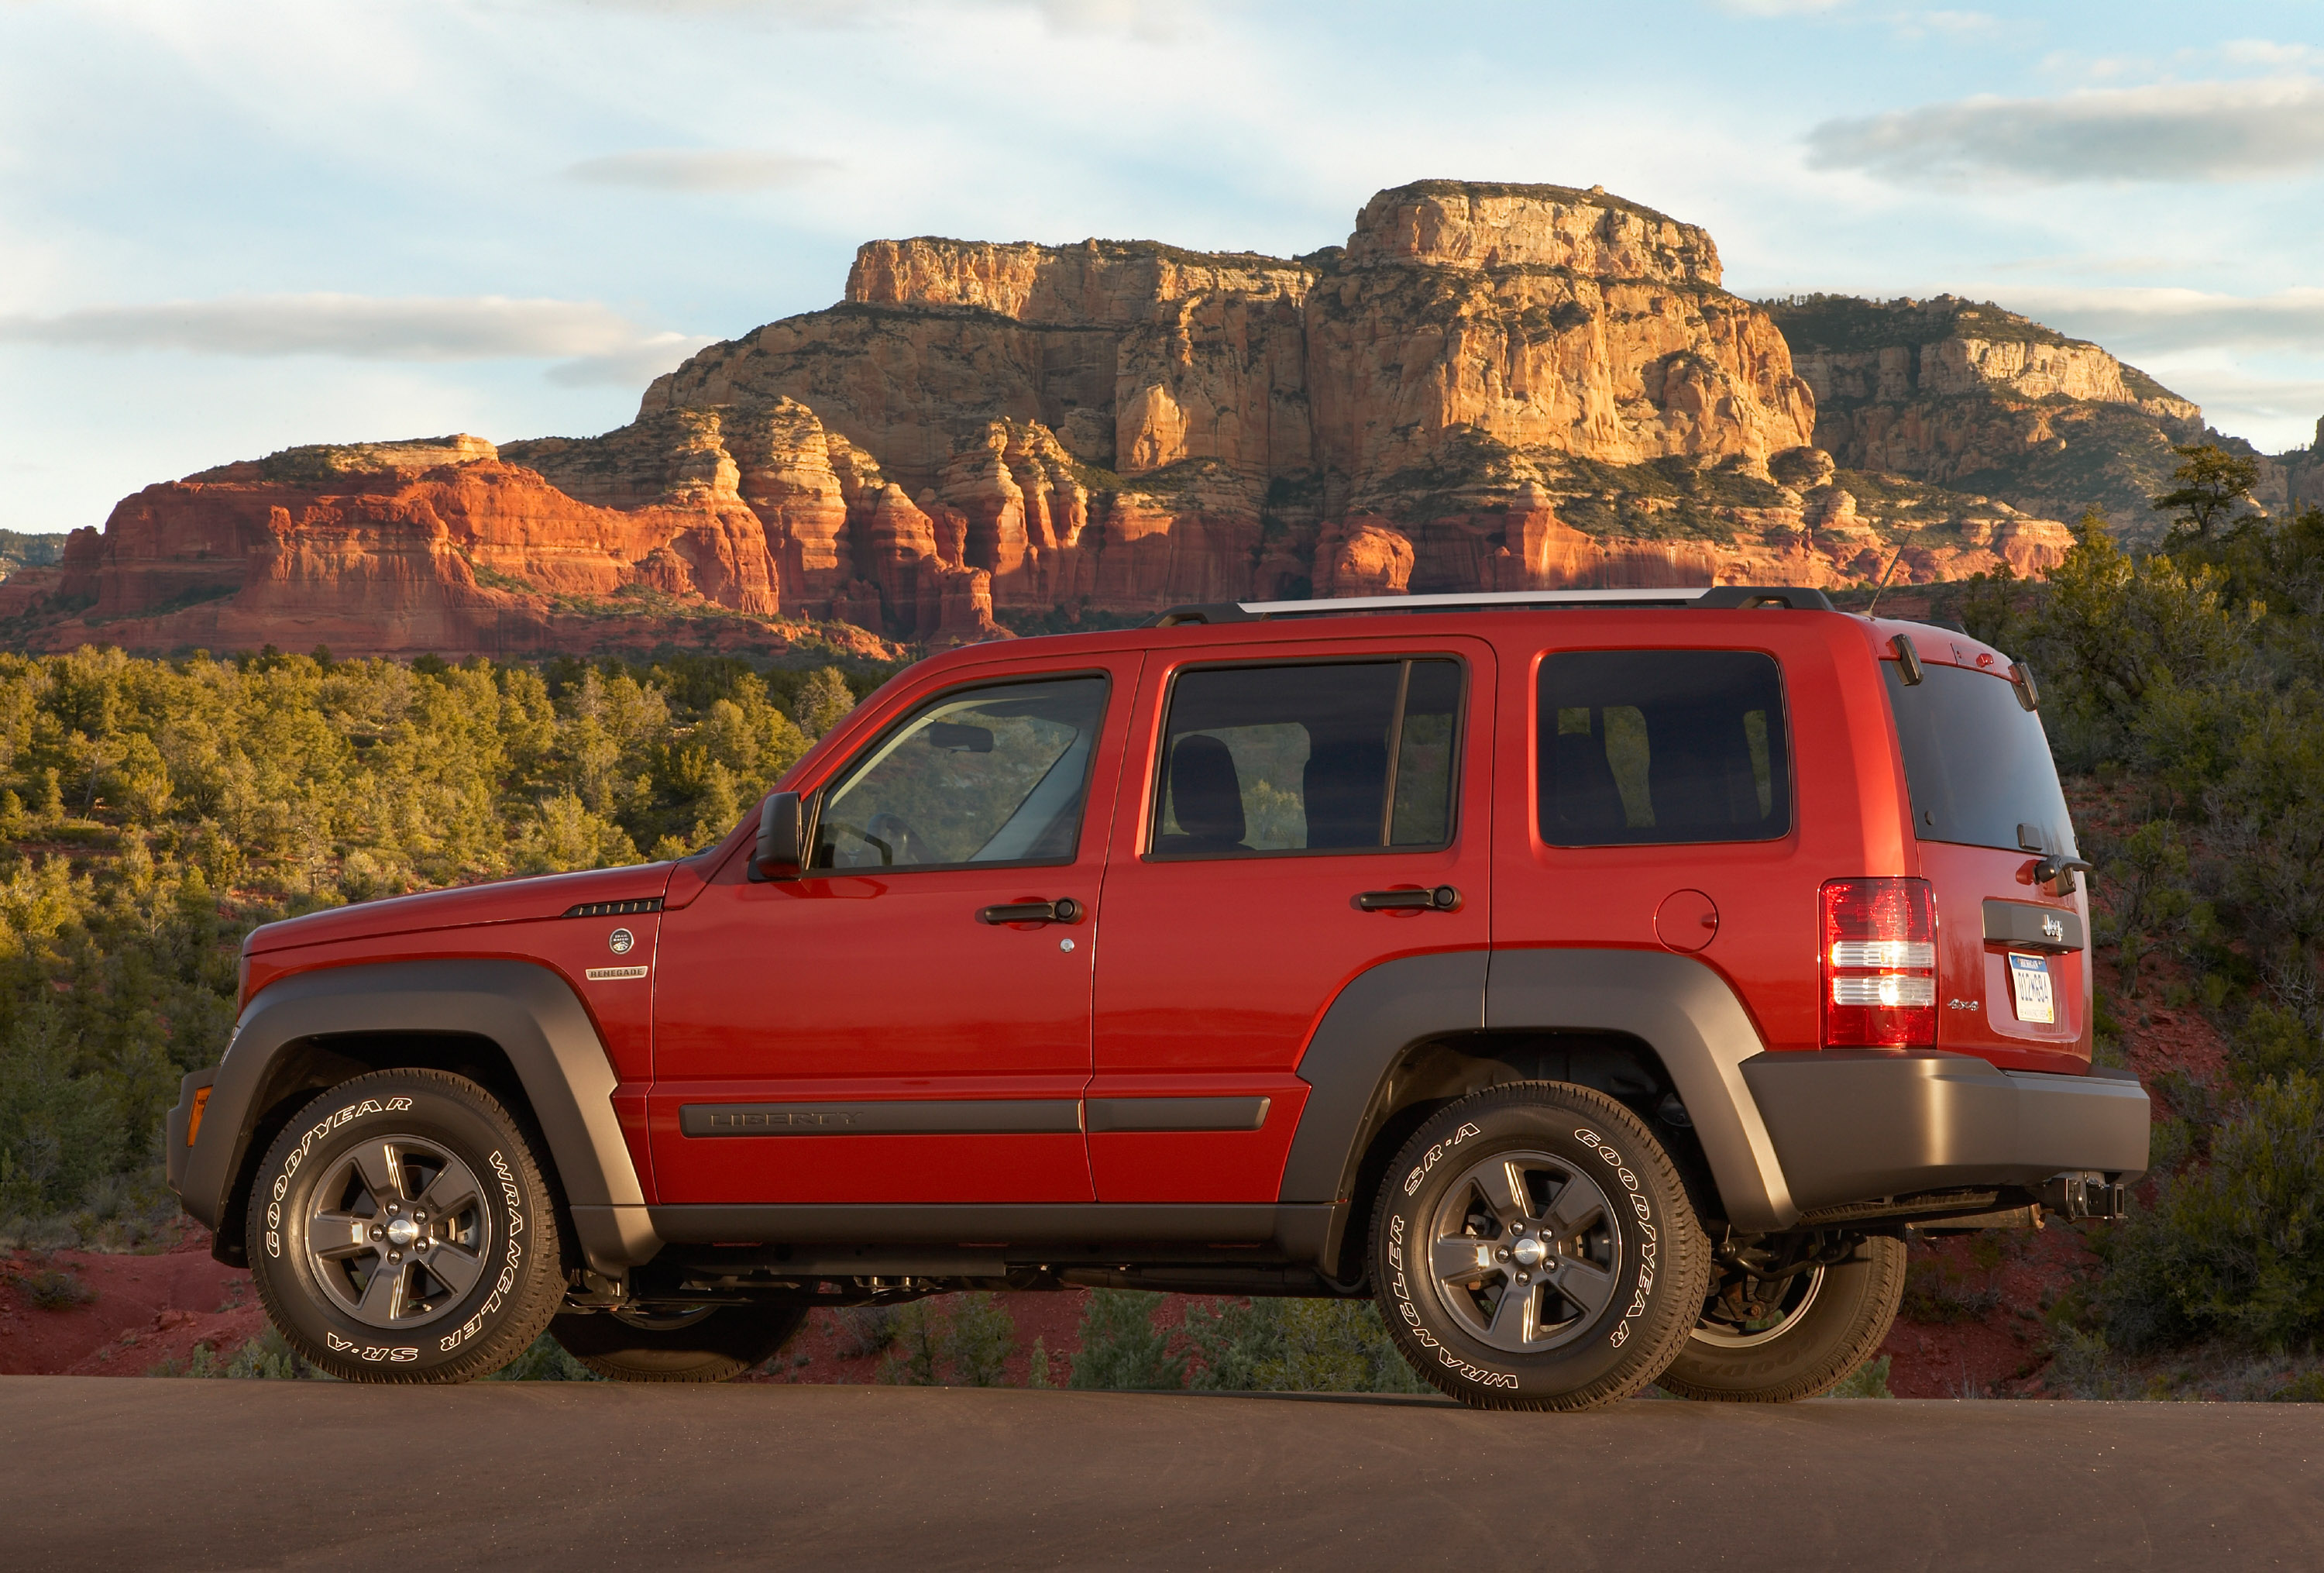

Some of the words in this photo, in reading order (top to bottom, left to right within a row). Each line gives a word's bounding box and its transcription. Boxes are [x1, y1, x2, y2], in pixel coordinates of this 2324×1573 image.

[590, 968, 643, 977] RENEGADE
[2042, 914, 2063, 942] Jeep
[266, 1096, 412, 1258] GOODYEAR
[710, 1111, 864, 1127] LIBERTY
[440, 1150, 524, 1351] WRANGLER
[1389, 1215, 1519, 1389] WRANGLER
[1574, 1128, 1656, 1348] GOODYEAR
